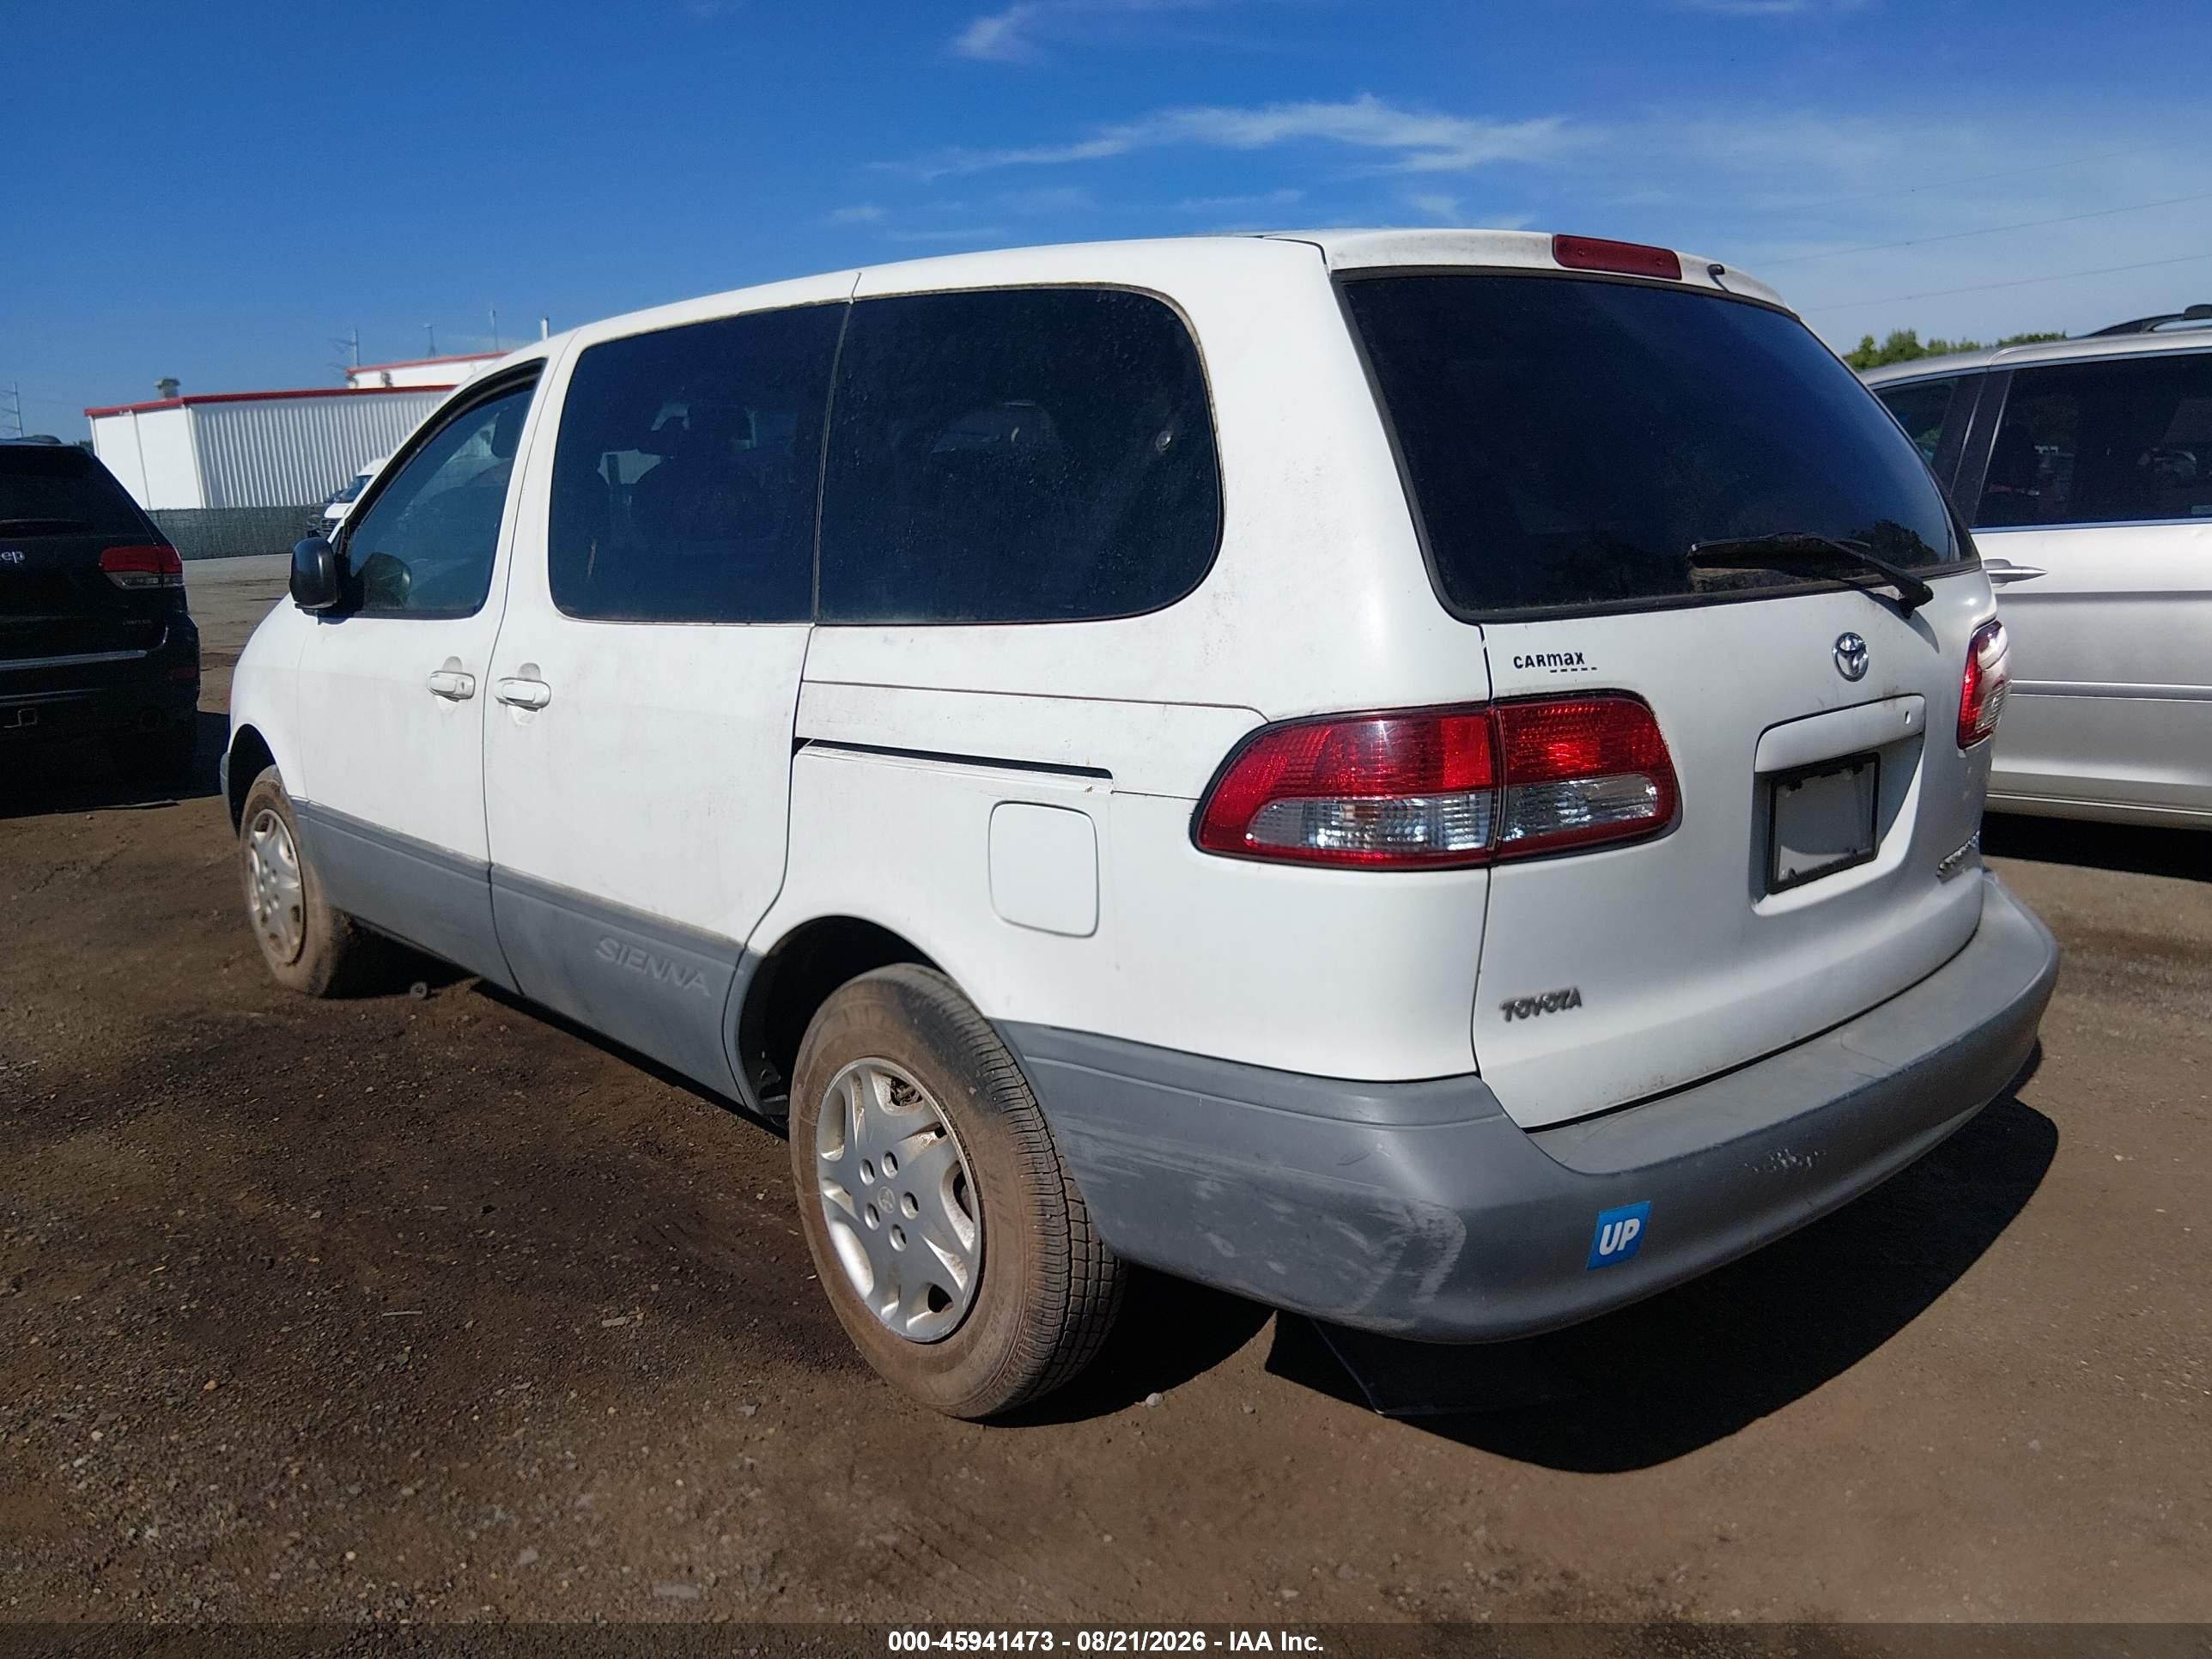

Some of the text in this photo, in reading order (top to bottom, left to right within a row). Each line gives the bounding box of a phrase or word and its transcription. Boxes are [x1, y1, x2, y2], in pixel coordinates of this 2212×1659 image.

[0, 551, 25, 564] ep
[596, 936, 711, 997] SIENNA
[1500, 987, 1582, 1022] TOYOTA
[1599, 1218, 1640, 1255] UP
